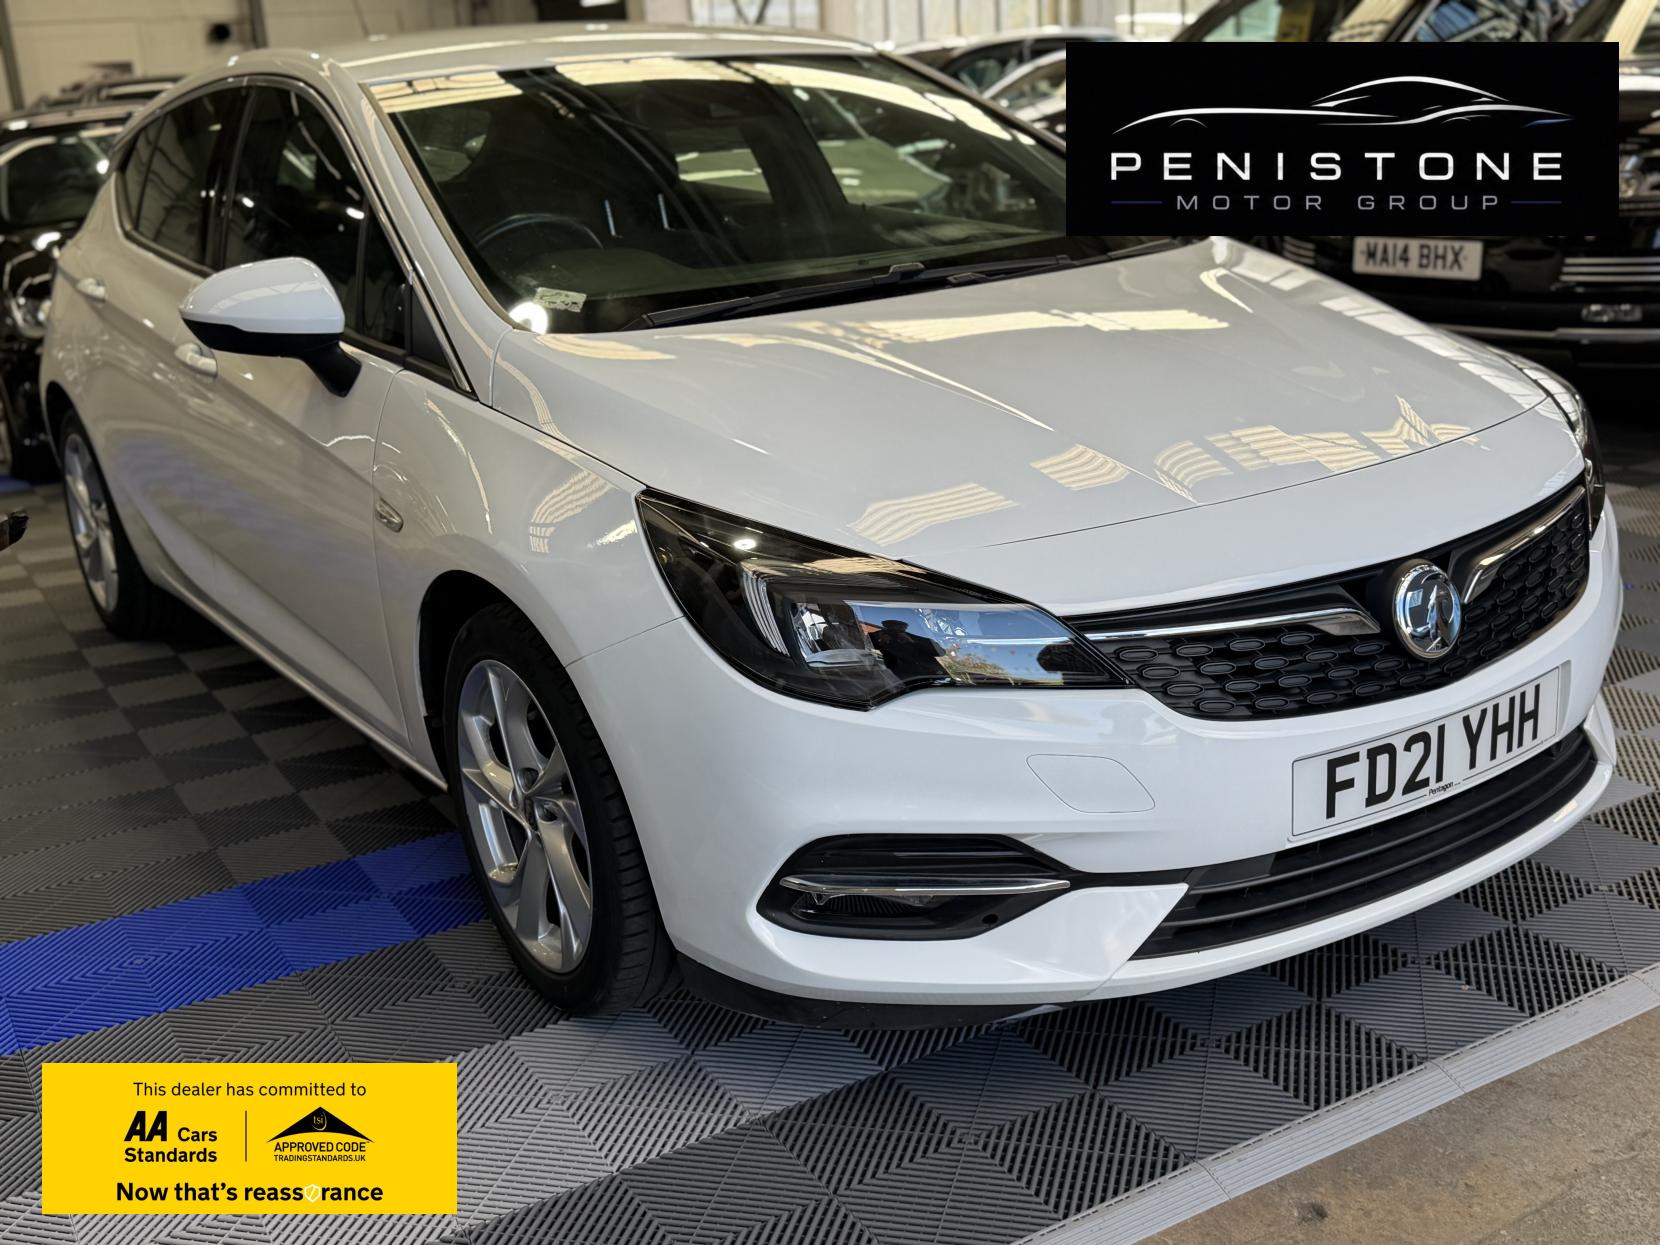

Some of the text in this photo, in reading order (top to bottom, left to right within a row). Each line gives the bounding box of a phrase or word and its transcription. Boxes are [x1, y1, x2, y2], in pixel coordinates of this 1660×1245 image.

[1418, 244, 1464, 270] BHX
[1326, 683, 1540, 819] FD21 YHH
[1428, 781, 1454, 796] Pentagon
